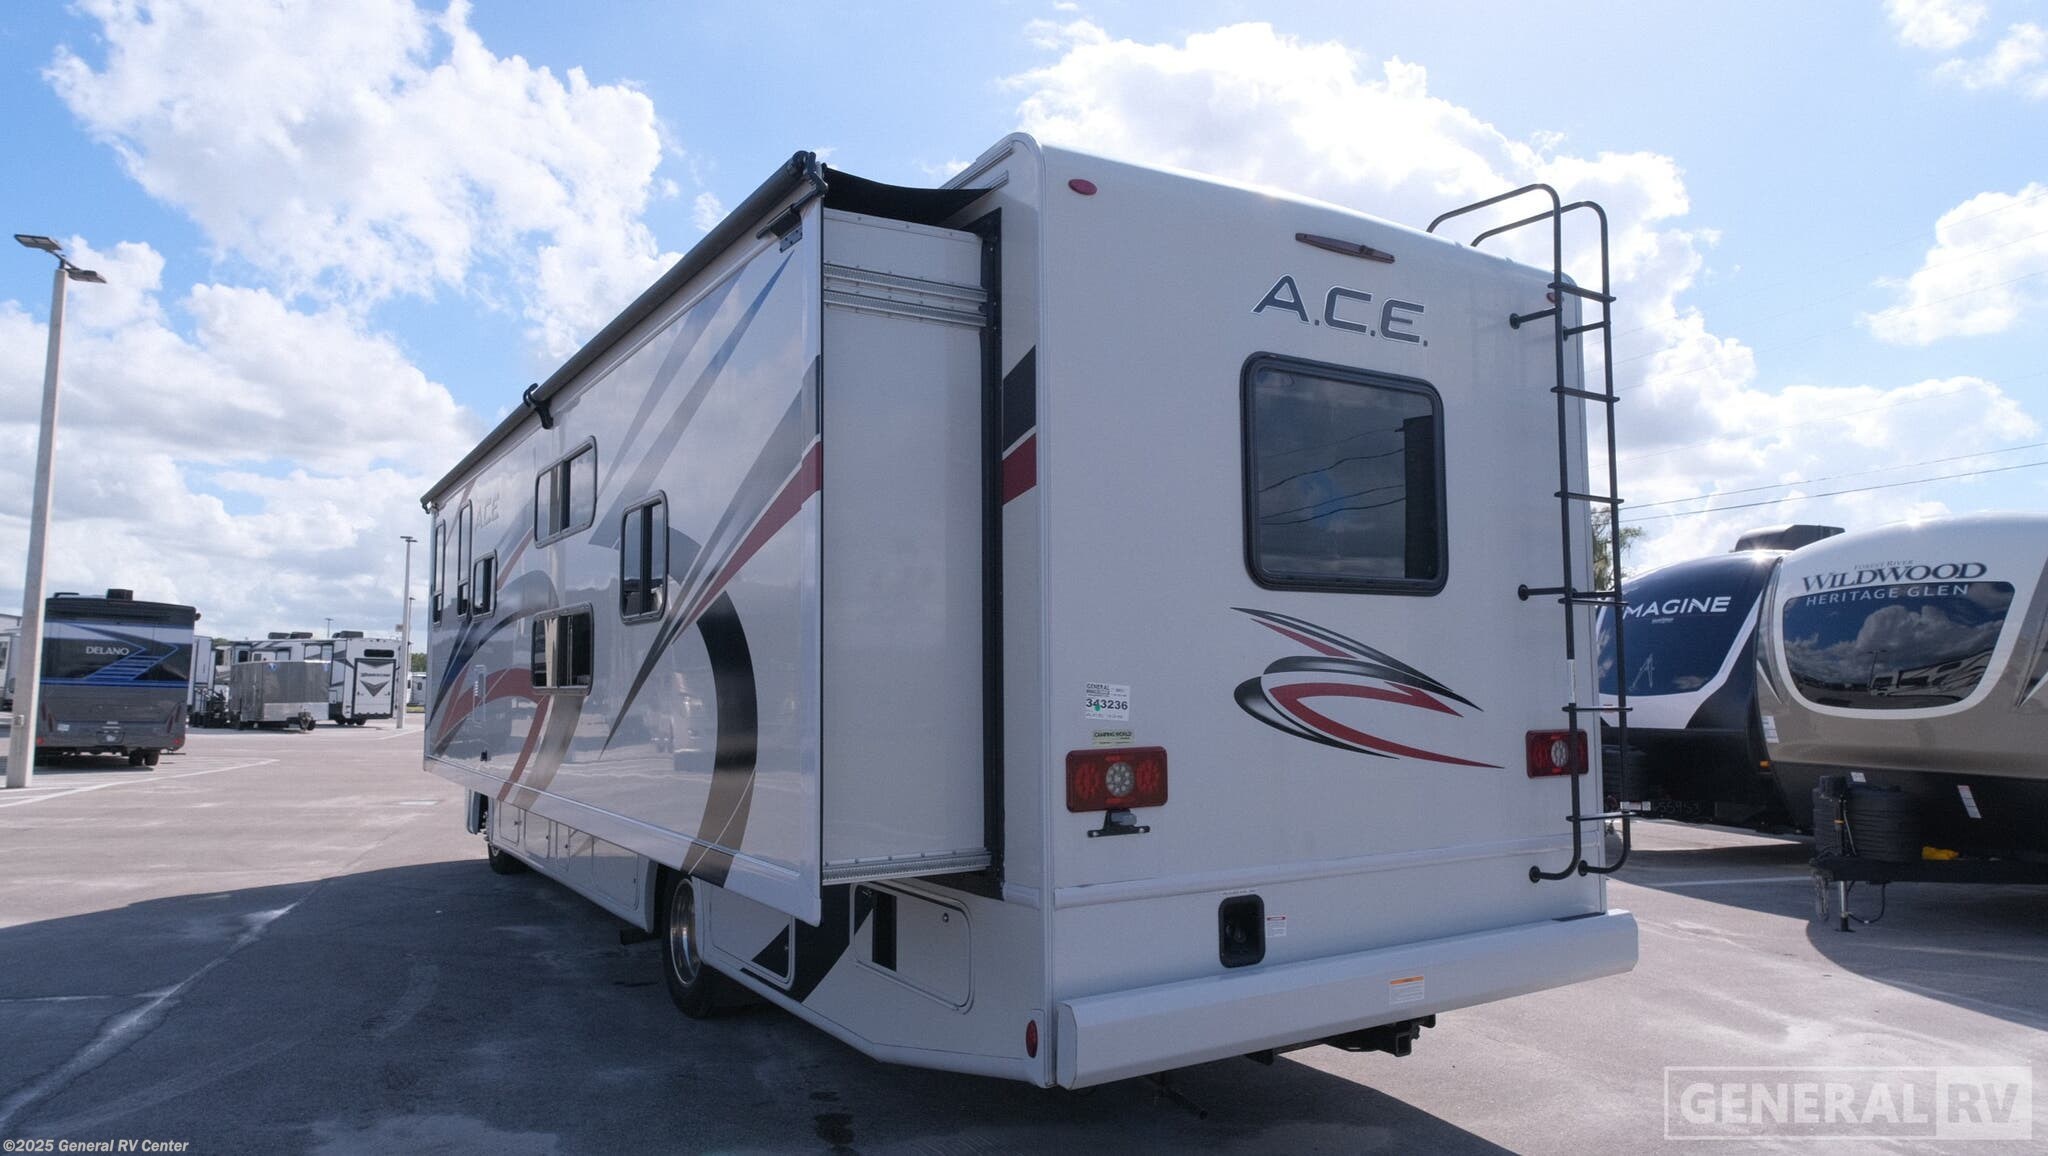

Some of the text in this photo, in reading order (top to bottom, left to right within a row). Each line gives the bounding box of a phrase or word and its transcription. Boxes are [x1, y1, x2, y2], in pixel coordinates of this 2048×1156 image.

[1252, 274, 1429, 348] A.C.E.
[1887, 559, 1914, 568] RIVER
[1802, 562, 1988, 593] WILDWOOD
[1806, 584, 1969, 607] HERITAGE GLEN
[1622, 596, 1732, 620] MAGINE
[86, 646, 130, 656] DELANO
[1086, 698, 1128, 710] 343236
